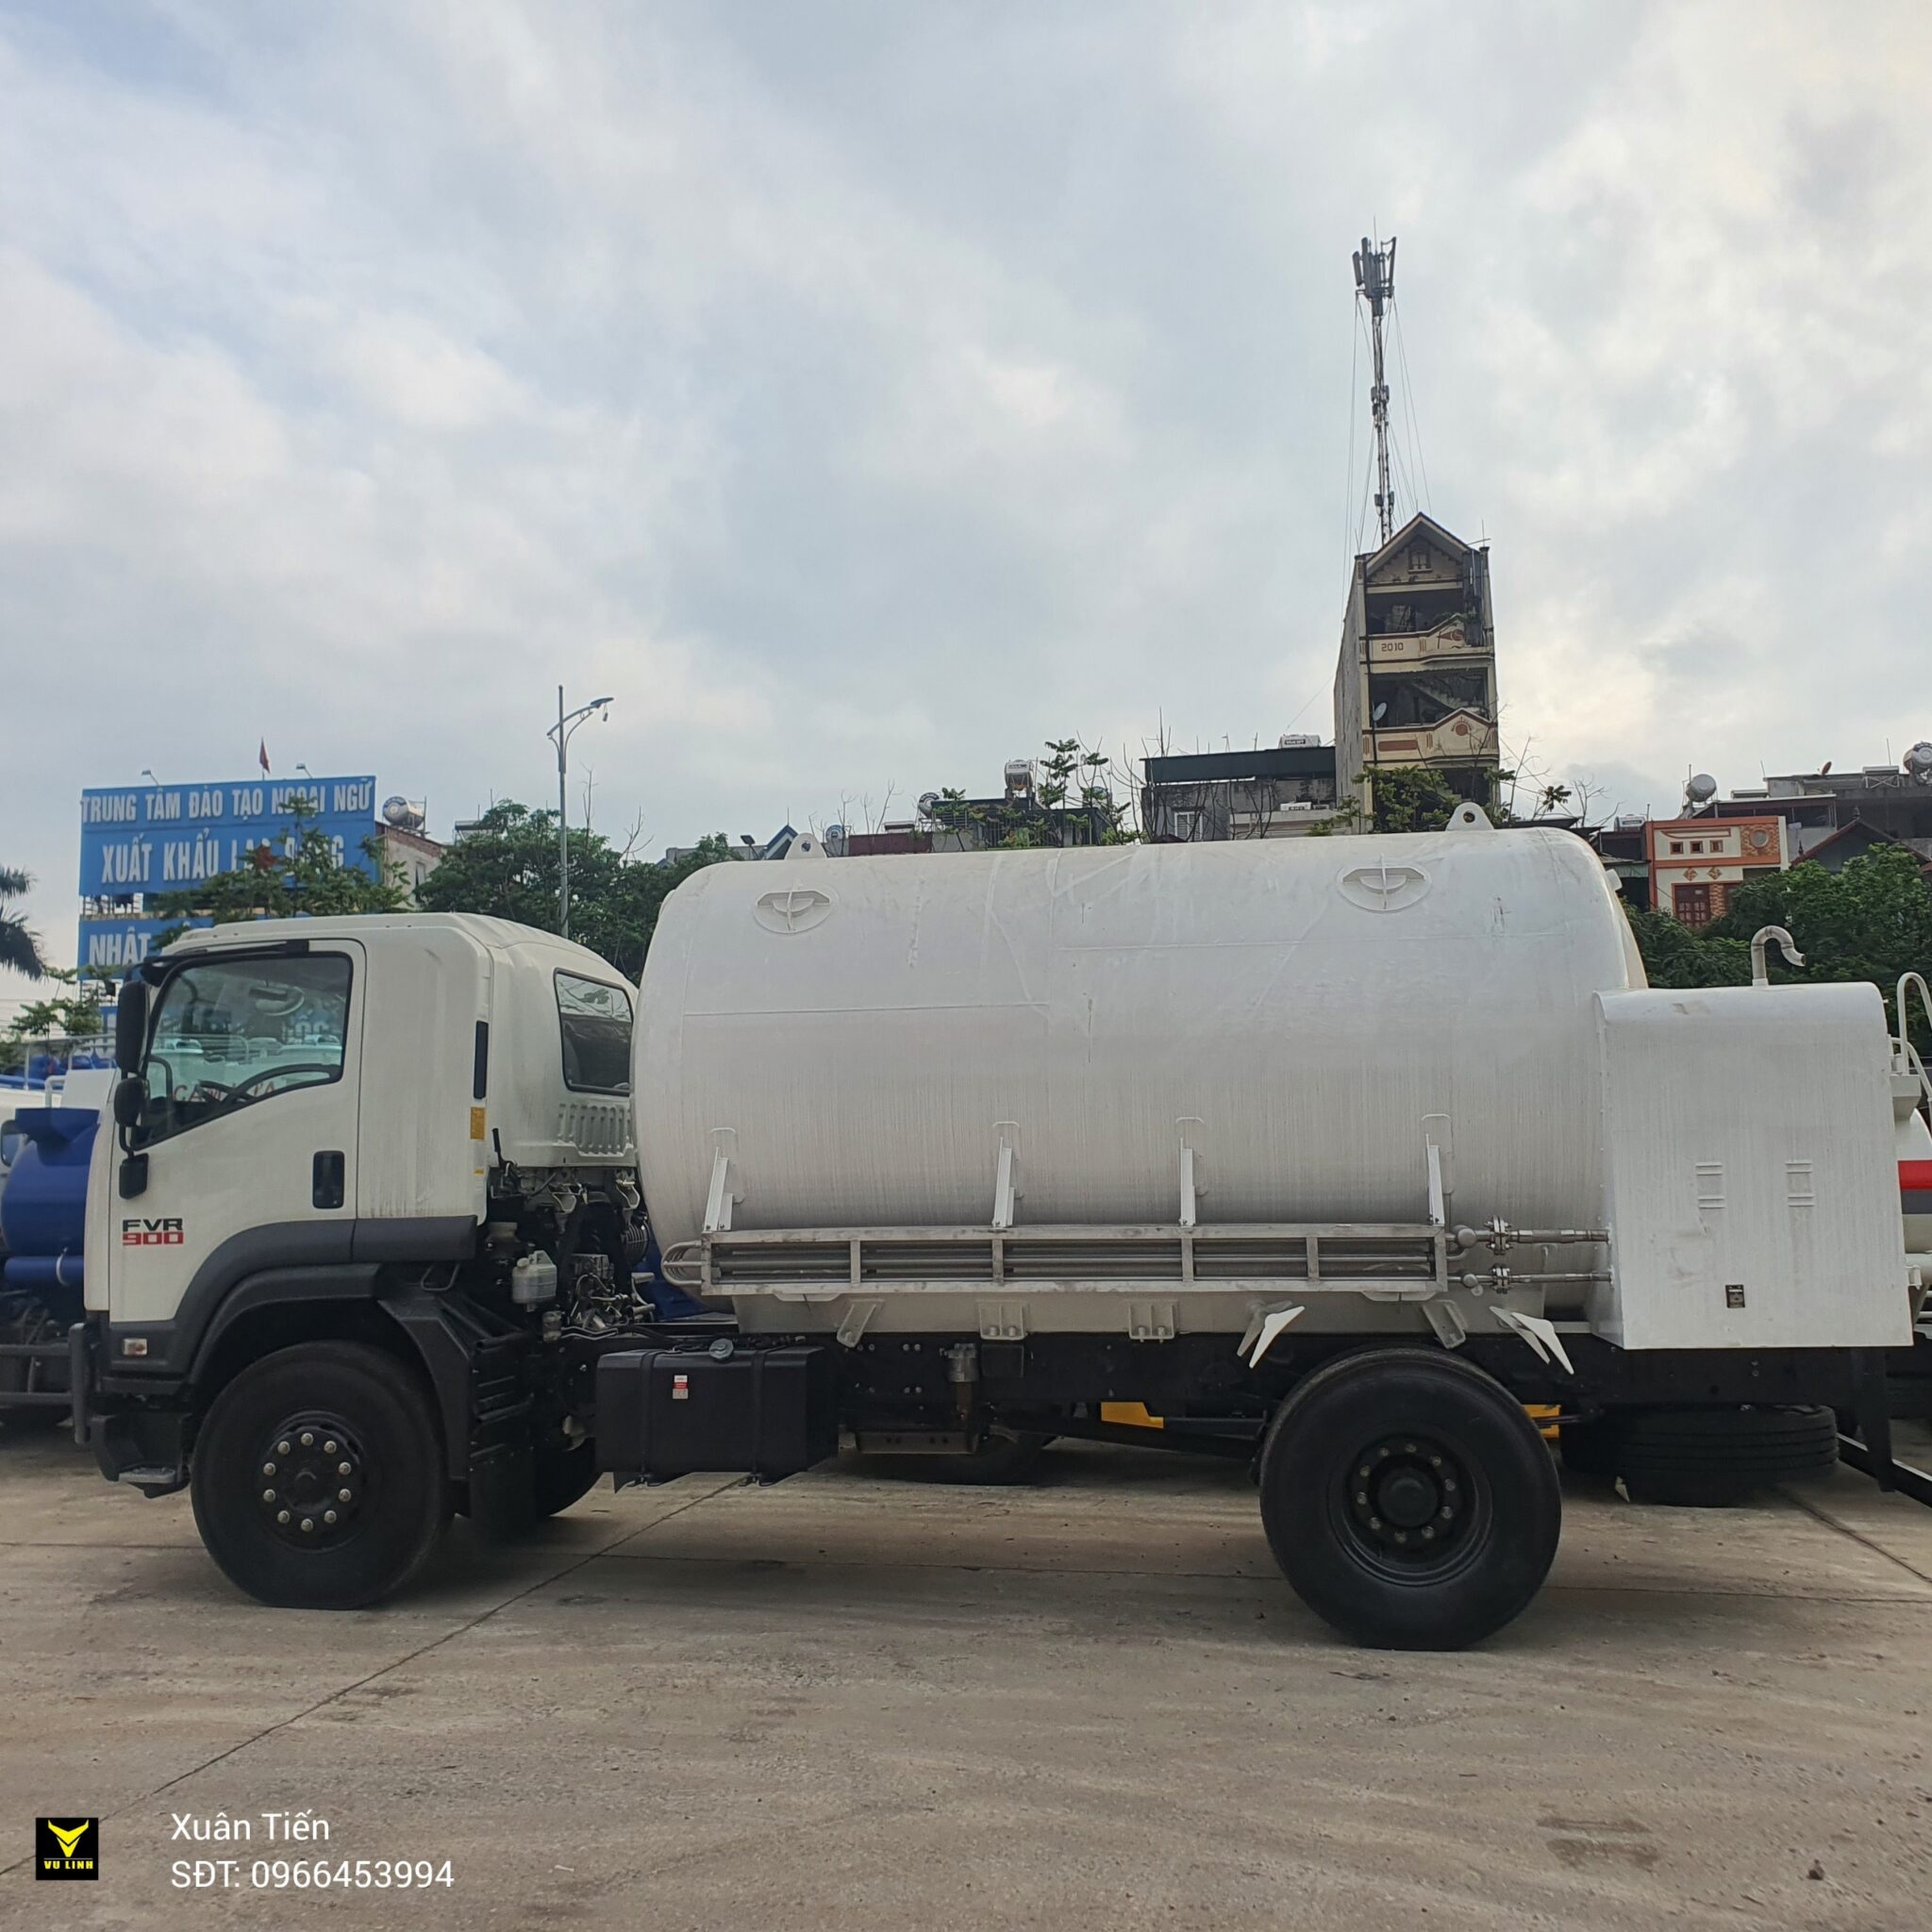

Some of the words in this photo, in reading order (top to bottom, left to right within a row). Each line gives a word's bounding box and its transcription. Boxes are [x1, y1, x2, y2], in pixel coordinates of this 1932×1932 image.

[1380, 641, 1404, 652] 2010
[80, 793, 137, 824] TRUNG
[145, 787, 181, 821] TÂM
[189, 784, 224, 819] ĐÀO
[232, 788, 263, 821] TẠO
[333, 777, 373, 812] NGỮ
[101, 832, 153, 884] XUẤT
[162, 827, 220, 881] KHẨU
[122, 1218, 184, 1232] FVR
[122, 1231, 184, 1245] 900
